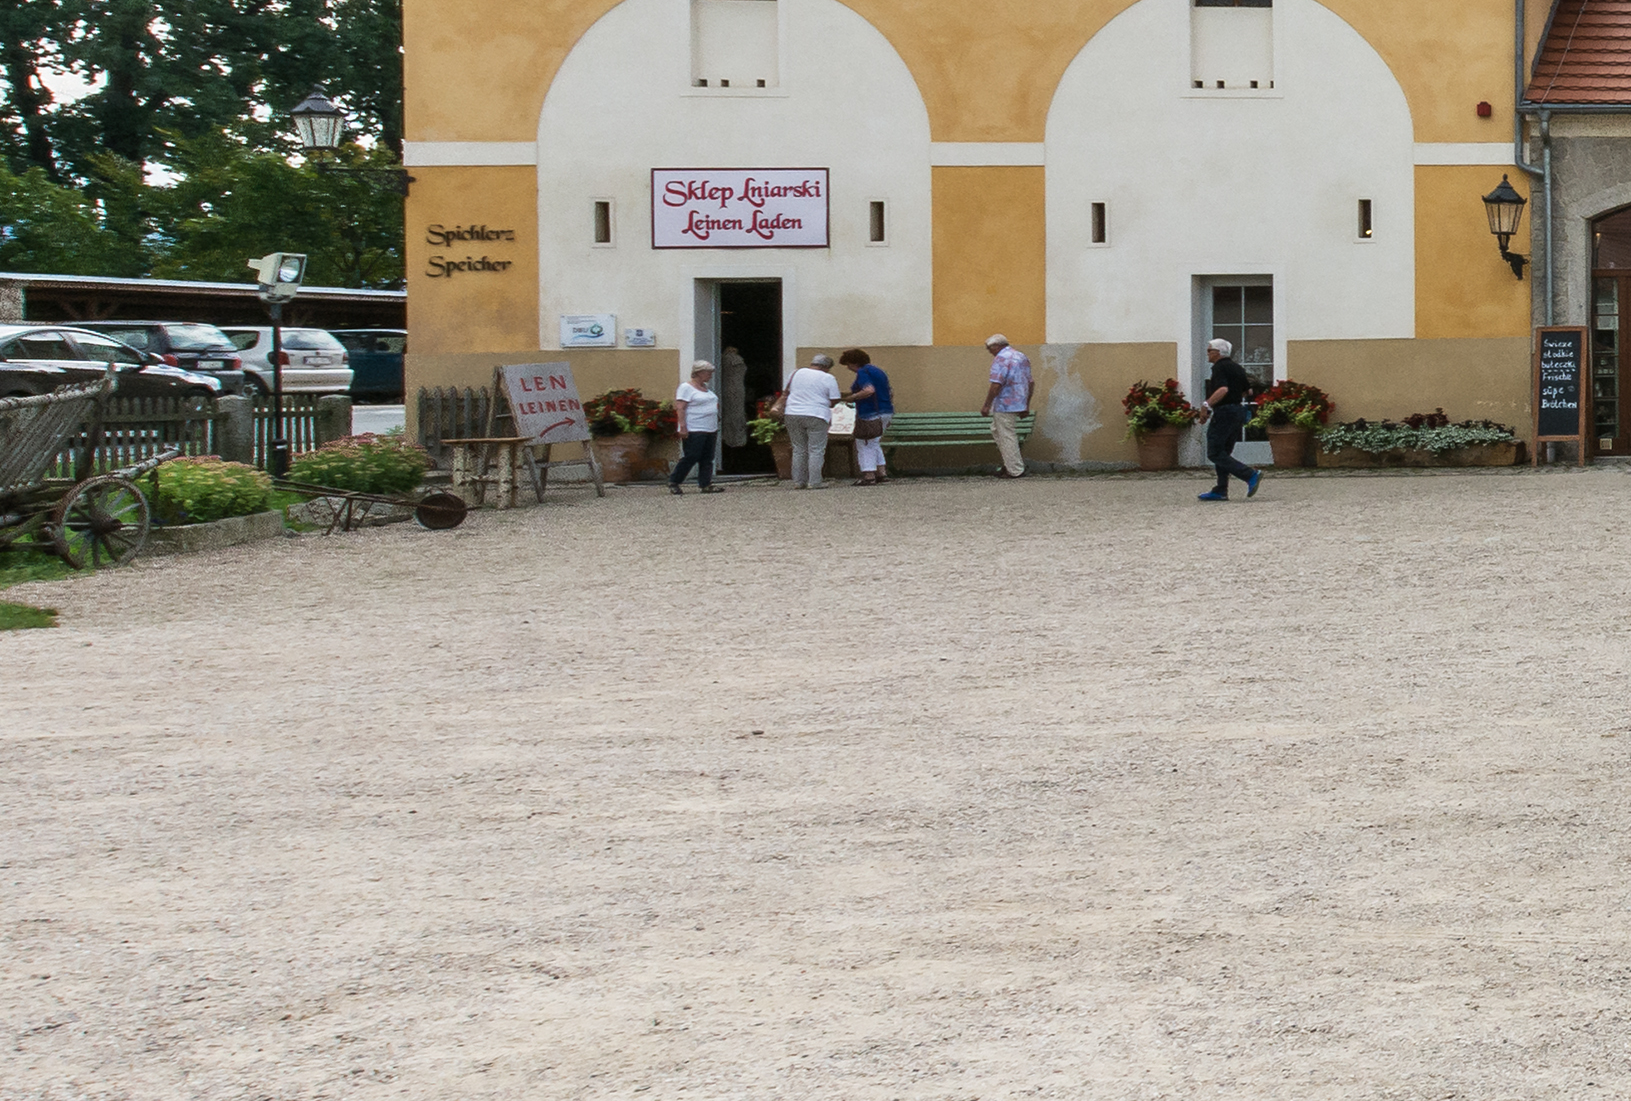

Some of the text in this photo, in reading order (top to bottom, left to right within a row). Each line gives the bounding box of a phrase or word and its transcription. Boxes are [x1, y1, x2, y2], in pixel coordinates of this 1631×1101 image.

[662, 177, 821, 209] Sklep Lniarski
[426, 224, 515, 247] Spichlerz
[681, 209, 802, 240] Leinen Laden
[425, 255, 512, 278] Speicher
[520, 375, 567, 392] LEN
[519, 399, 580, 415] LEINEN
